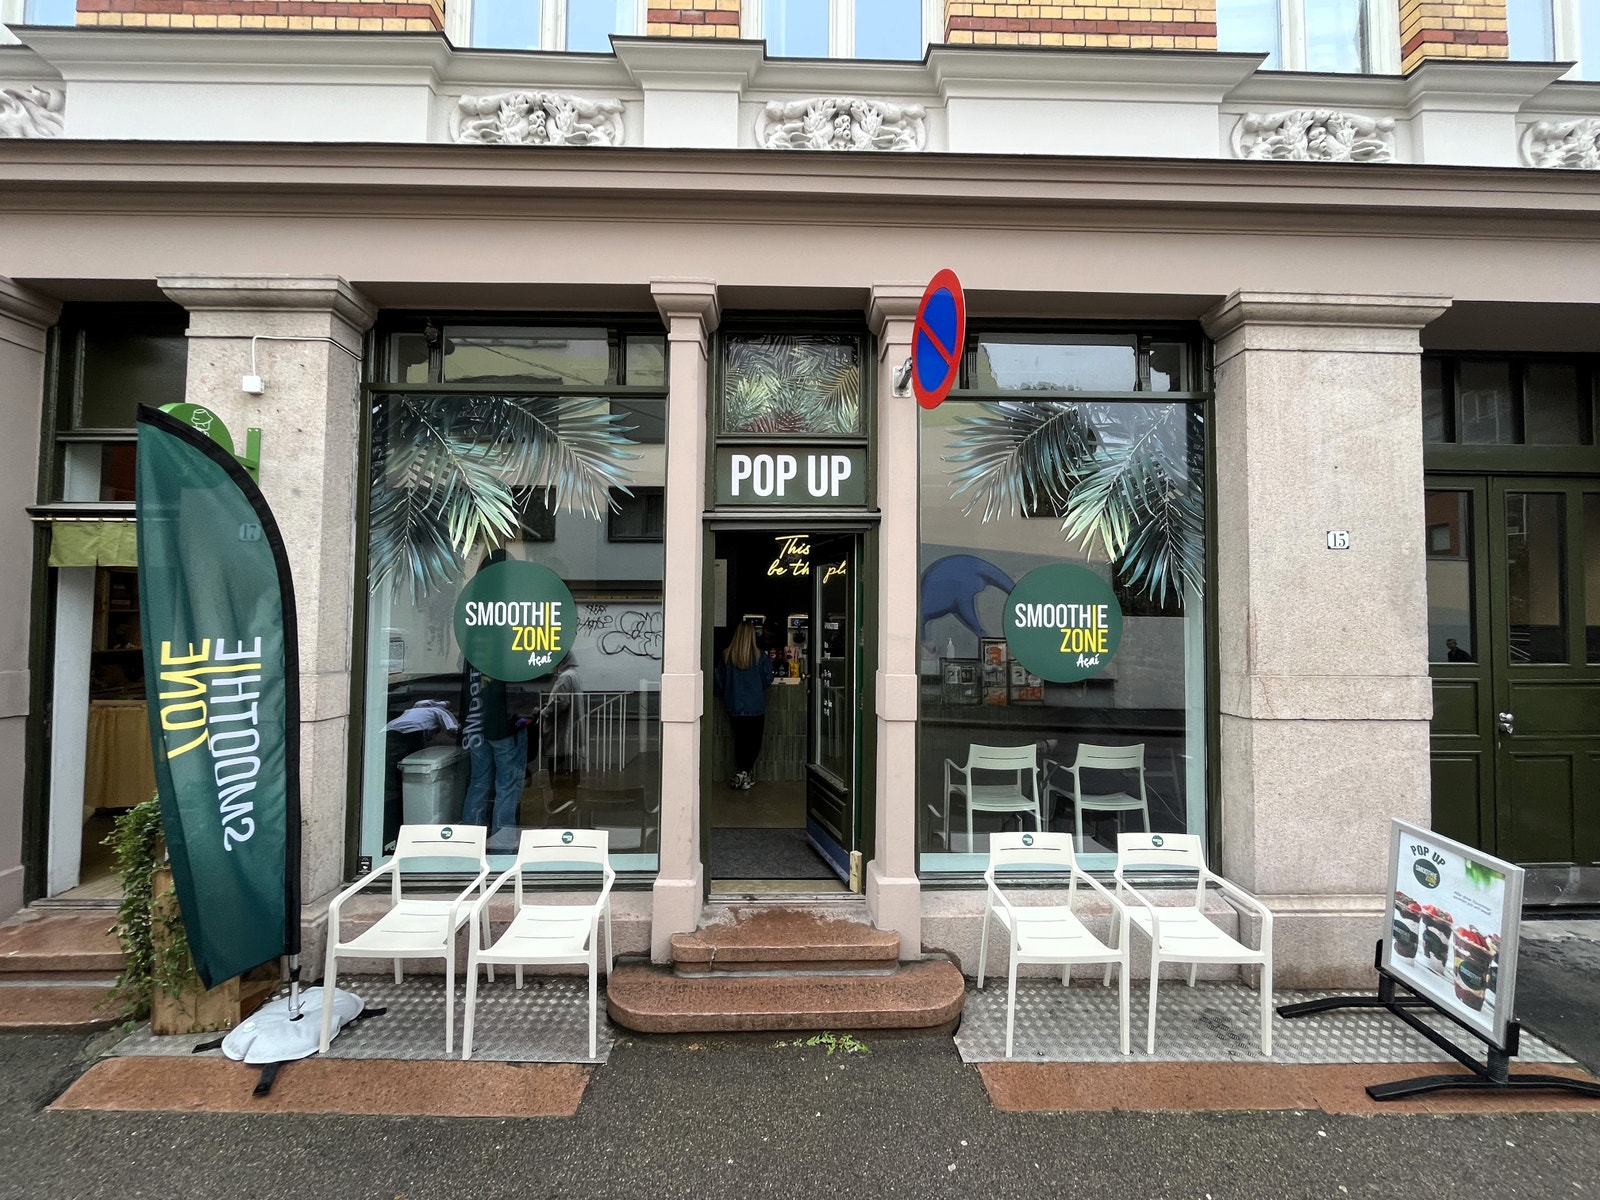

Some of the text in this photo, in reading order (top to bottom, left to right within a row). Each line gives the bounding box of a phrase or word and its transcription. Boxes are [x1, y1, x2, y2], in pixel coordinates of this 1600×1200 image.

[731, 454, 851, 497] POP UP
[243, 524, 257, 540] 17
[1333, 533, 1346, 547] 15
[774, 534, 811, 559] This
[767, 558, 788, 576] be
[465, 601, 562, 627] SMOOTHIE
[1015, 603, 1109, 628] SMOOTHIE
[511, 626, 562, 651] ZONE
[1060, 628, 1109, 653] ZONE
[1410, 845, 1446, 866] POP UP
